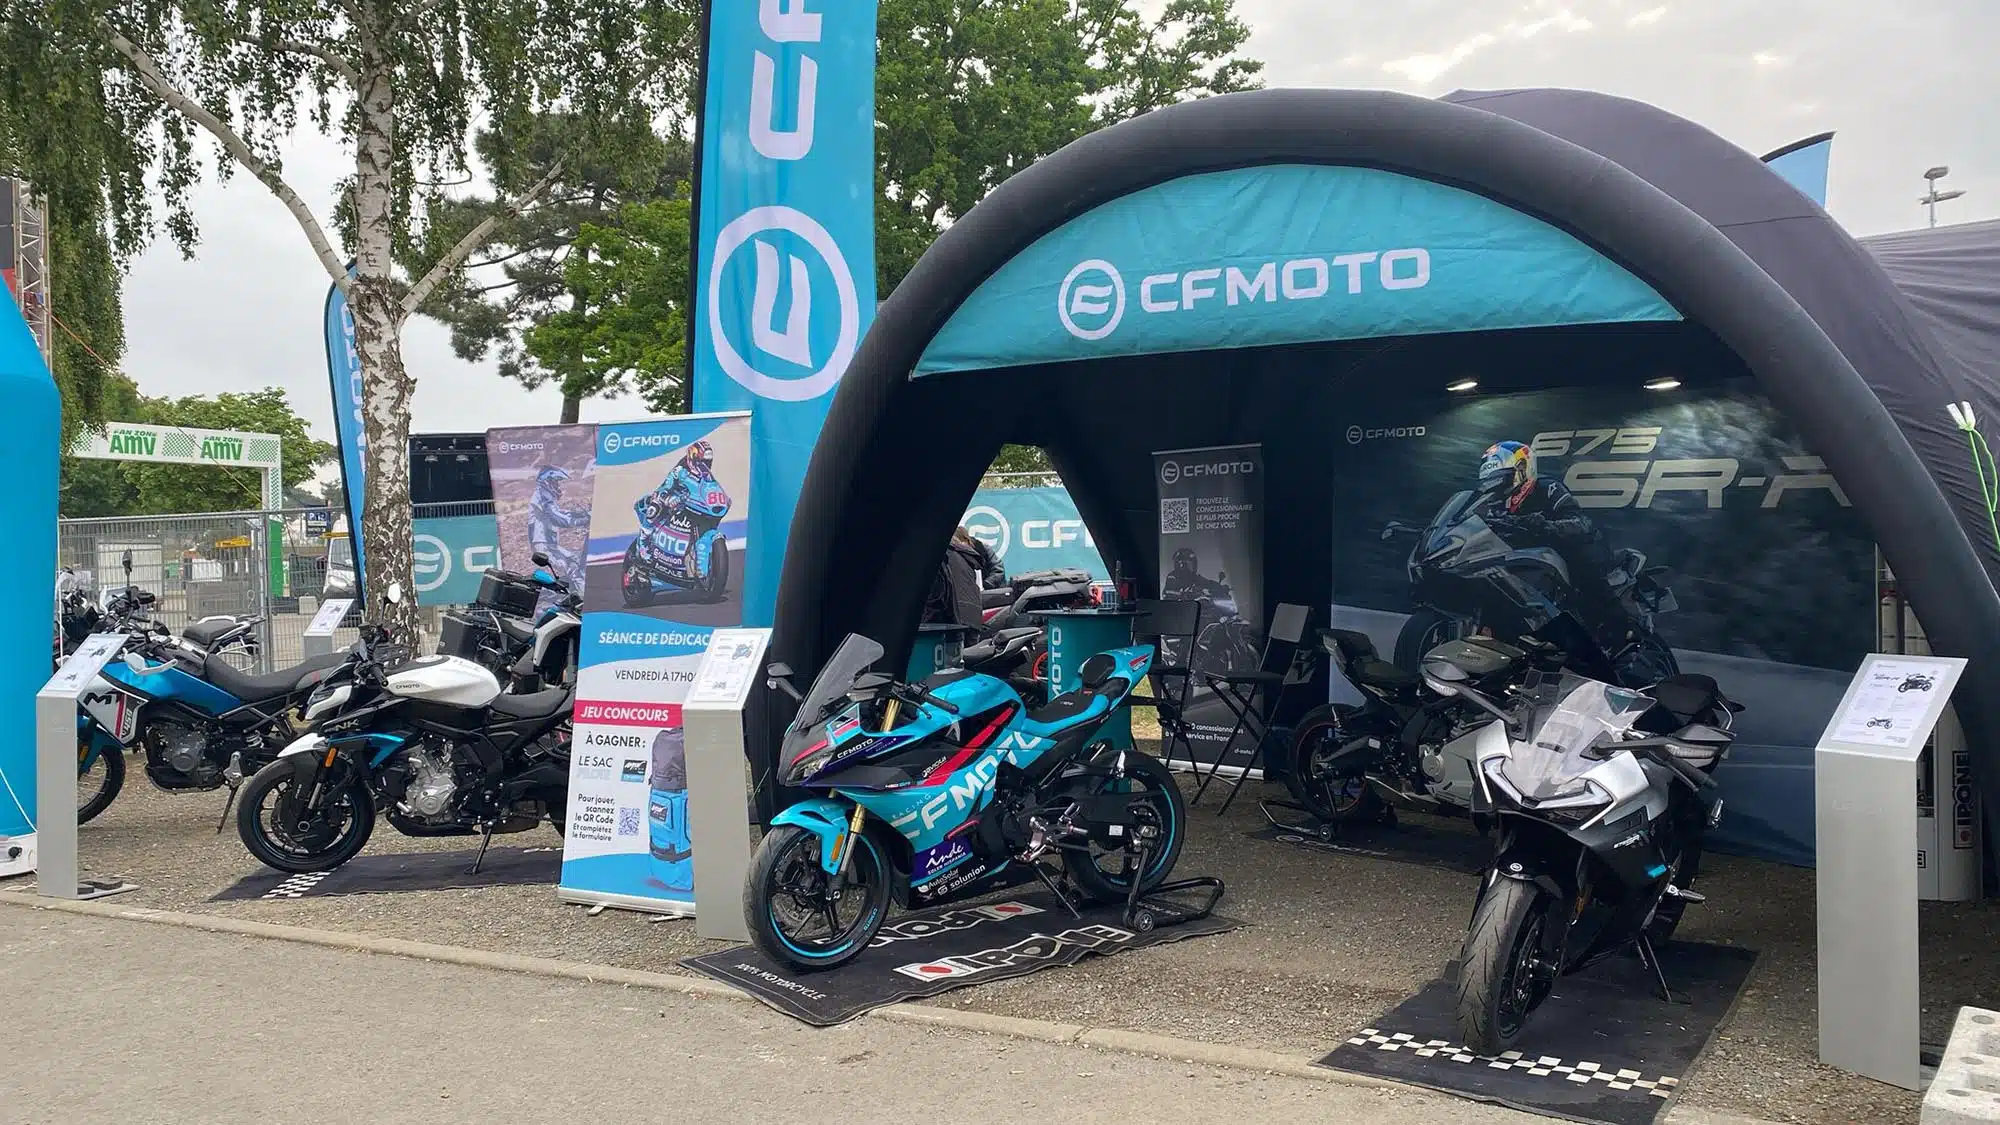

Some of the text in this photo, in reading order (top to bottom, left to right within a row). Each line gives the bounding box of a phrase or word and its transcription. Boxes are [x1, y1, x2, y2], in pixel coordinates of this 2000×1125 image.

[1140, 247, 1431, 313] CFMOTO
[1366, 426, 1426, 439] CFMOTO
[510, 443, 544, 451] CFMOTO
[623, 434, 680, 448] CFMOTO
[1532, 427, 1663, 457] 675
[1183, 461, 1254, 477] CFMOTO
[1196, 504, 1254, 513] CONCESSIONNAIRE
[1217, 512, 1240, 520] PROCHE
[1196, 522, 1204, 530] DE
[1220, 521, 1236, 529] VOUS
[599, 629, 643, 645] SÉANCE
[644, 632, 659, 645] DE
[615, 668, 697, 682] VENDREDI À 17H0
[581, 705, 669, 721] JEU CONCOURS
[586, 730, 593, 744] À
[595, 734, 641, 748] GAGNER
[837, 738, 874, 759] CFMOTO
[578, 755, 613, 768] LE SAC
[578, 793, 594, 803] Pour
[585, 806, 615, 815] scannez
[582, 814, 594, 822] QR
[595, 814, 614, 824] Code
[573, 822, 579, 830] Et
[579, 832, 612, 841] formulaire
[949, 864, 986, 889] solunion
[758, 971, 827, 1000] MOTORCYCLE
